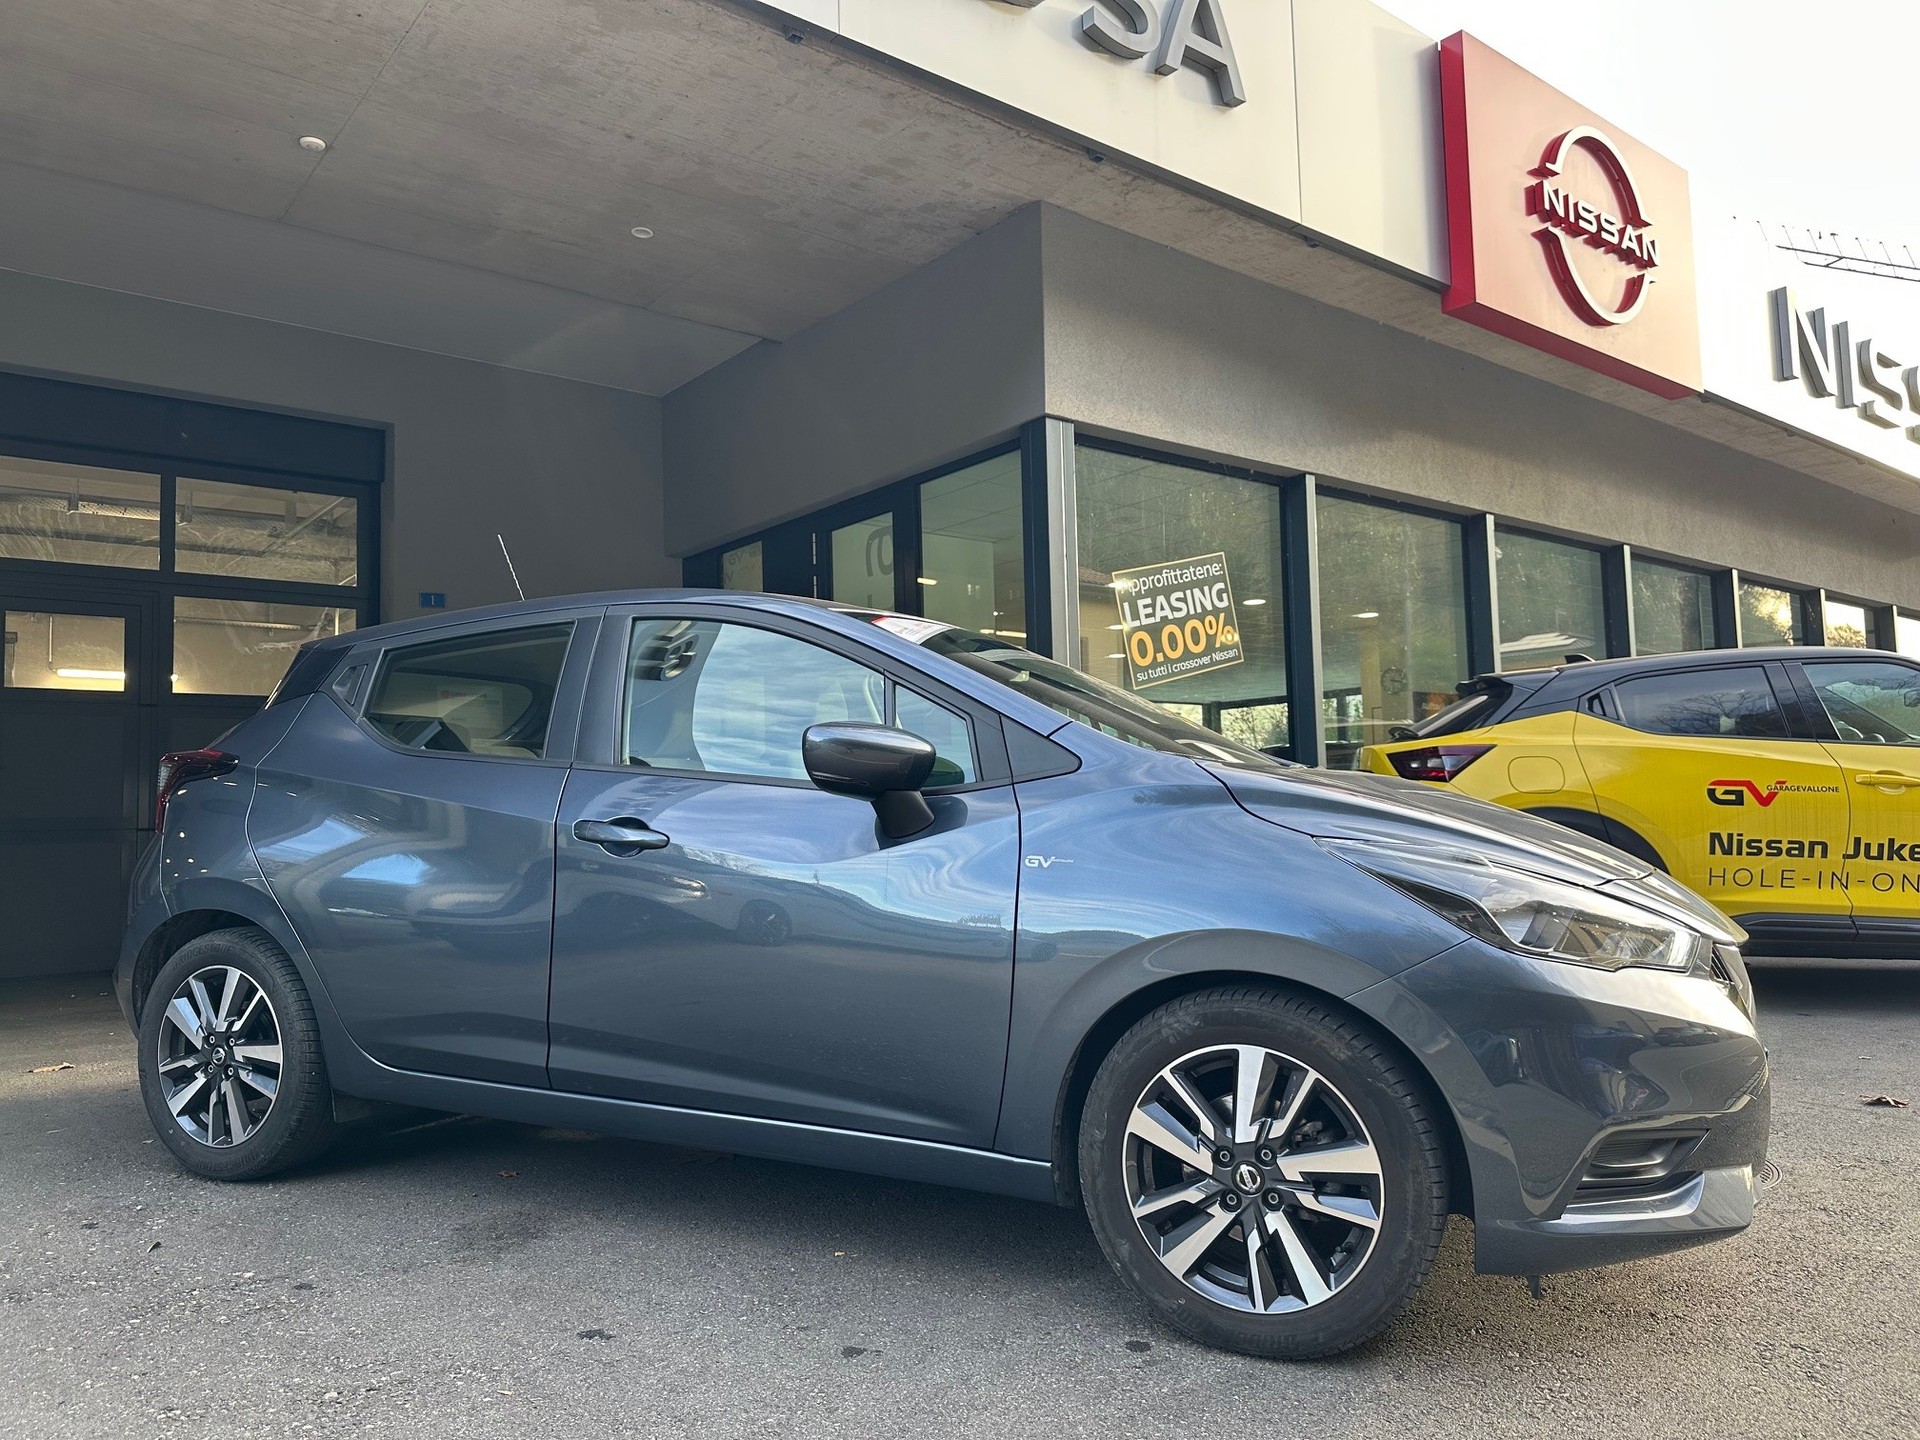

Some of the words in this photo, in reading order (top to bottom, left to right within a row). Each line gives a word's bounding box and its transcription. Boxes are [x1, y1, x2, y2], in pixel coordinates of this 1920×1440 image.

[1543, 180, 1660, 267] NISSAN
[1123, 582, 1230, 628] LEASING
[1130, 612, 1235, 667] 0.00%
[1136, 671, 1148, 681] su
[1148, 664, 1168, 678] tutti
[1172, 655, 1211, 671] crossover
[1212, 648, 1238, 661] Nissan
[1707, 779, 1788, 807] GV
[1766, 783, 1840, 793] GARAGEVALLONE
[1709, 832, 1829, 858] Nissan
[1842, 836, 1920, 862] Juke
[1708, 867, 1920, 893] HOLE-IN-ON
